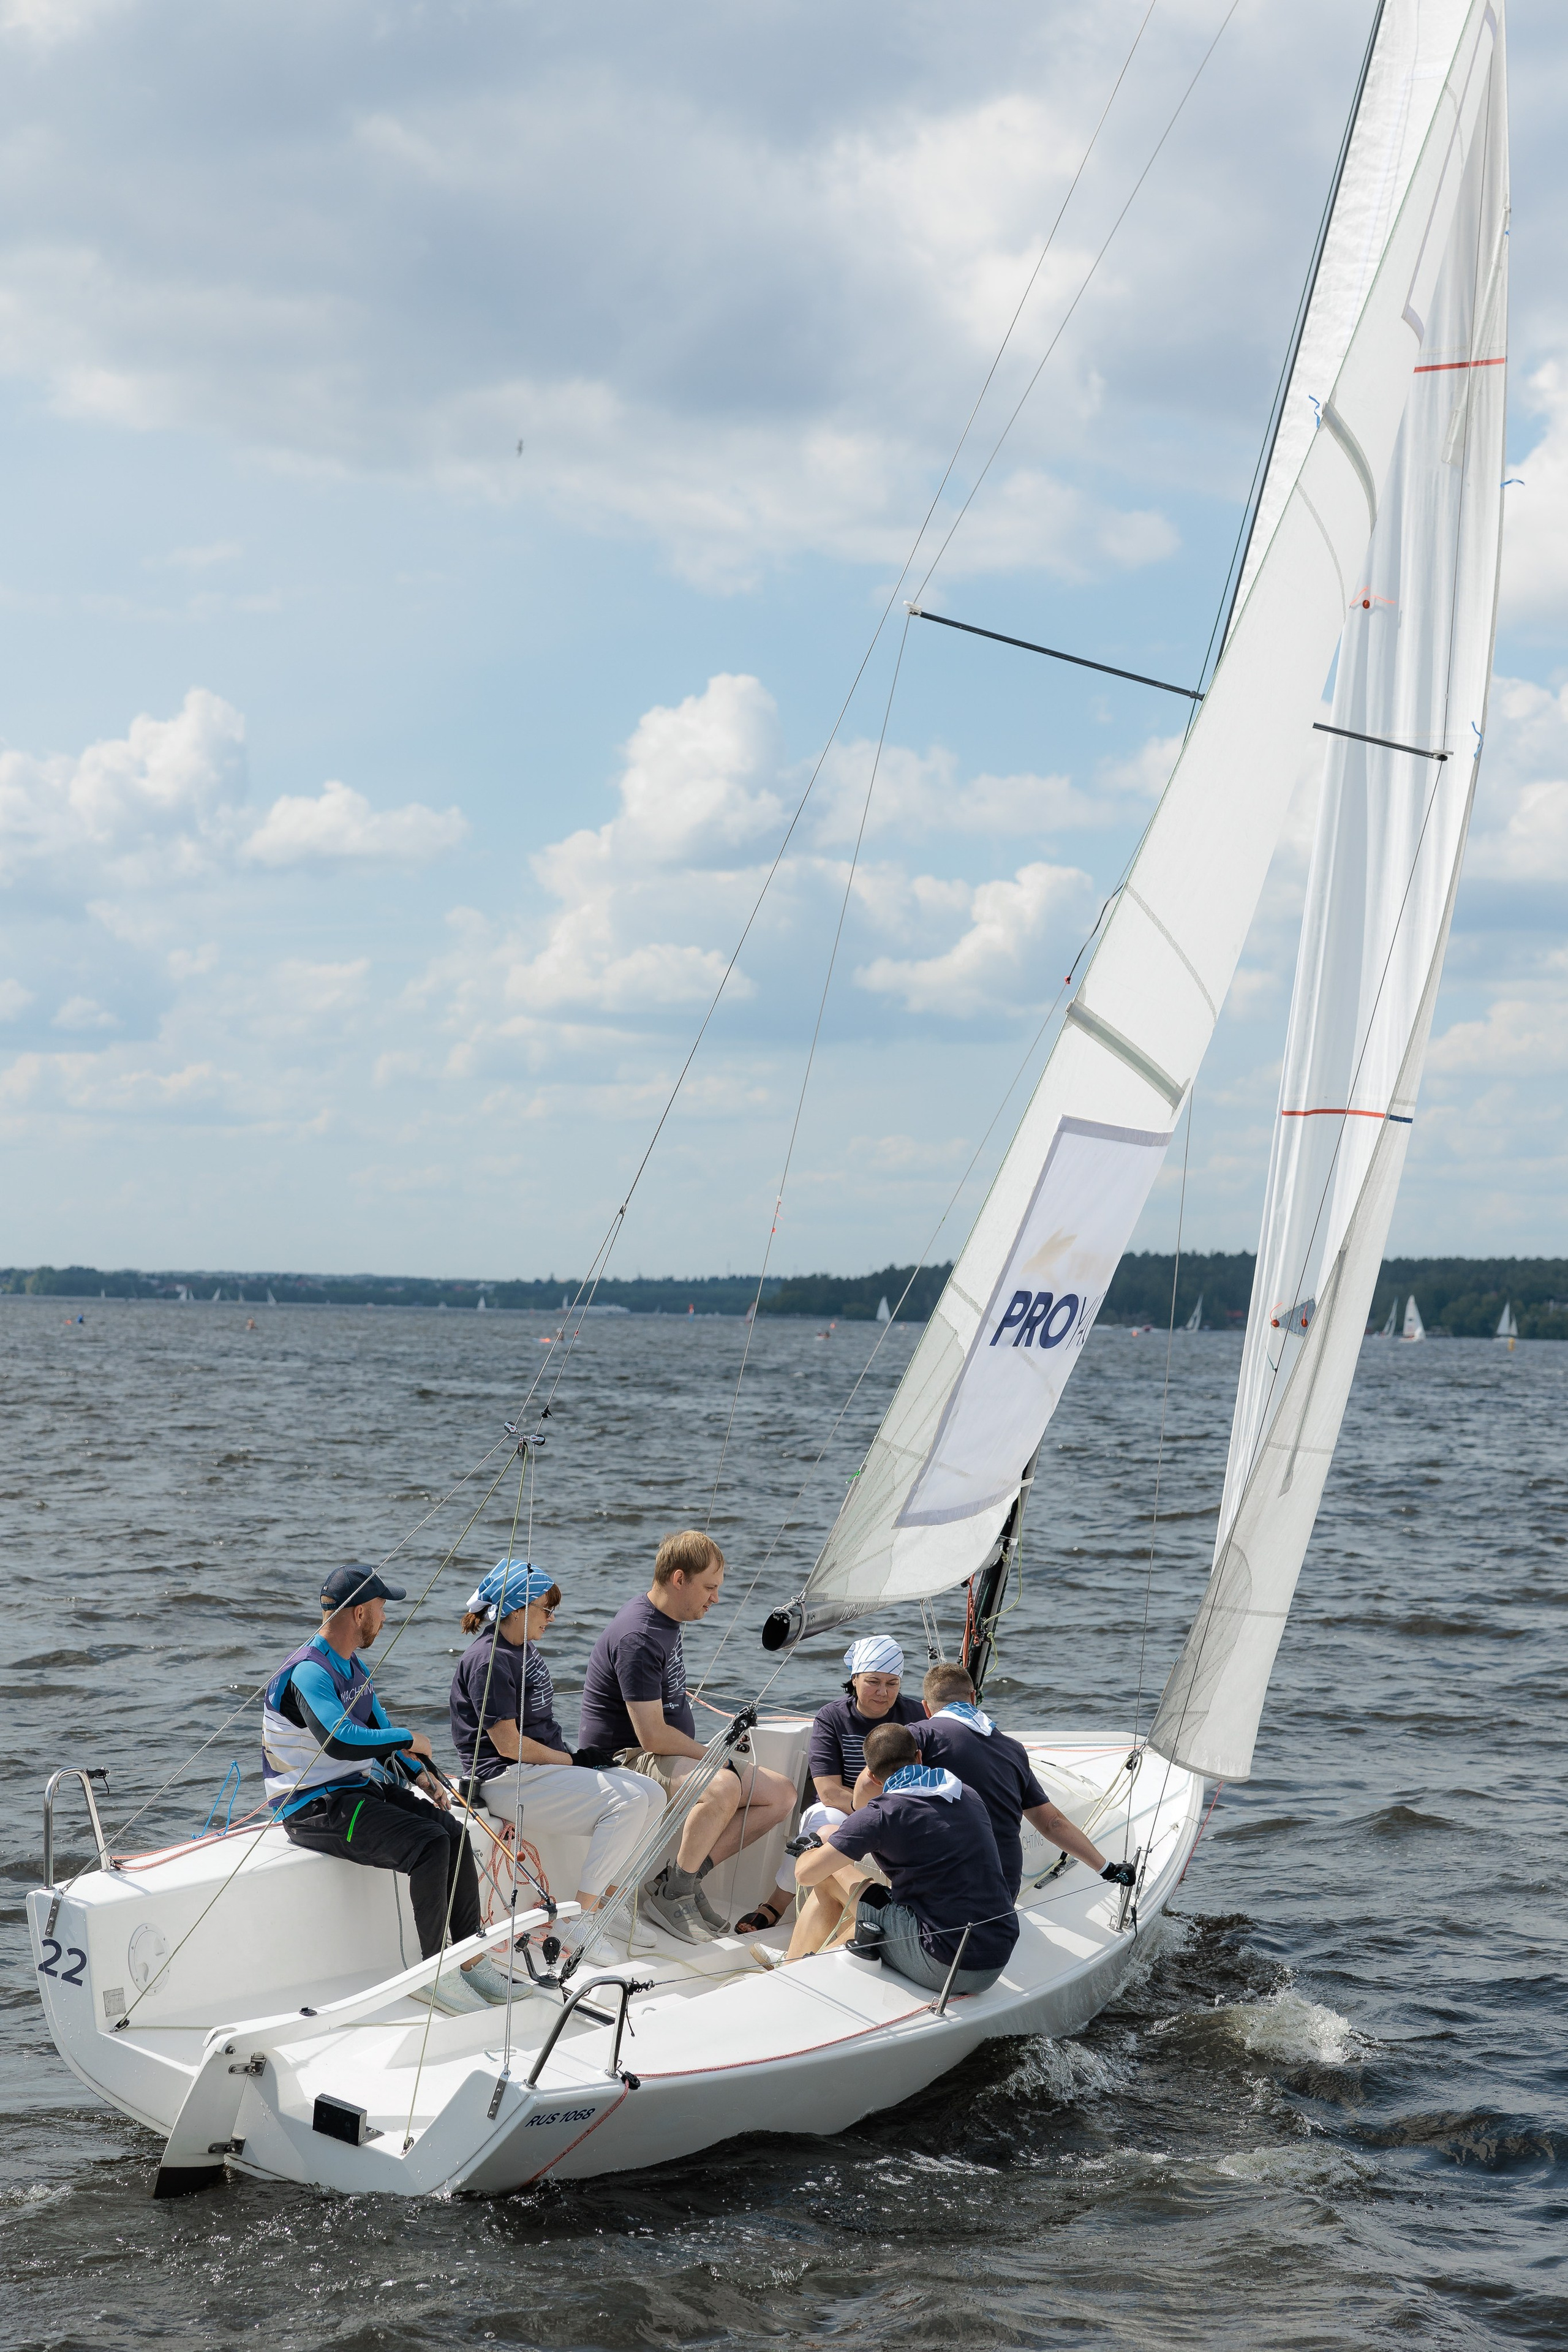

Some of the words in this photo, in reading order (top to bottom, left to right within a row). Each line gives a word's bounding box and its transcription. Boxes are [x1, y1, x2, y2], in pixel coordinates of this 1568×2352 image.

[38, 1939, 87, 1986] 22
[525, 2113, 560, 2127] RUS
[559, 2108, 596, 2123] 1068
